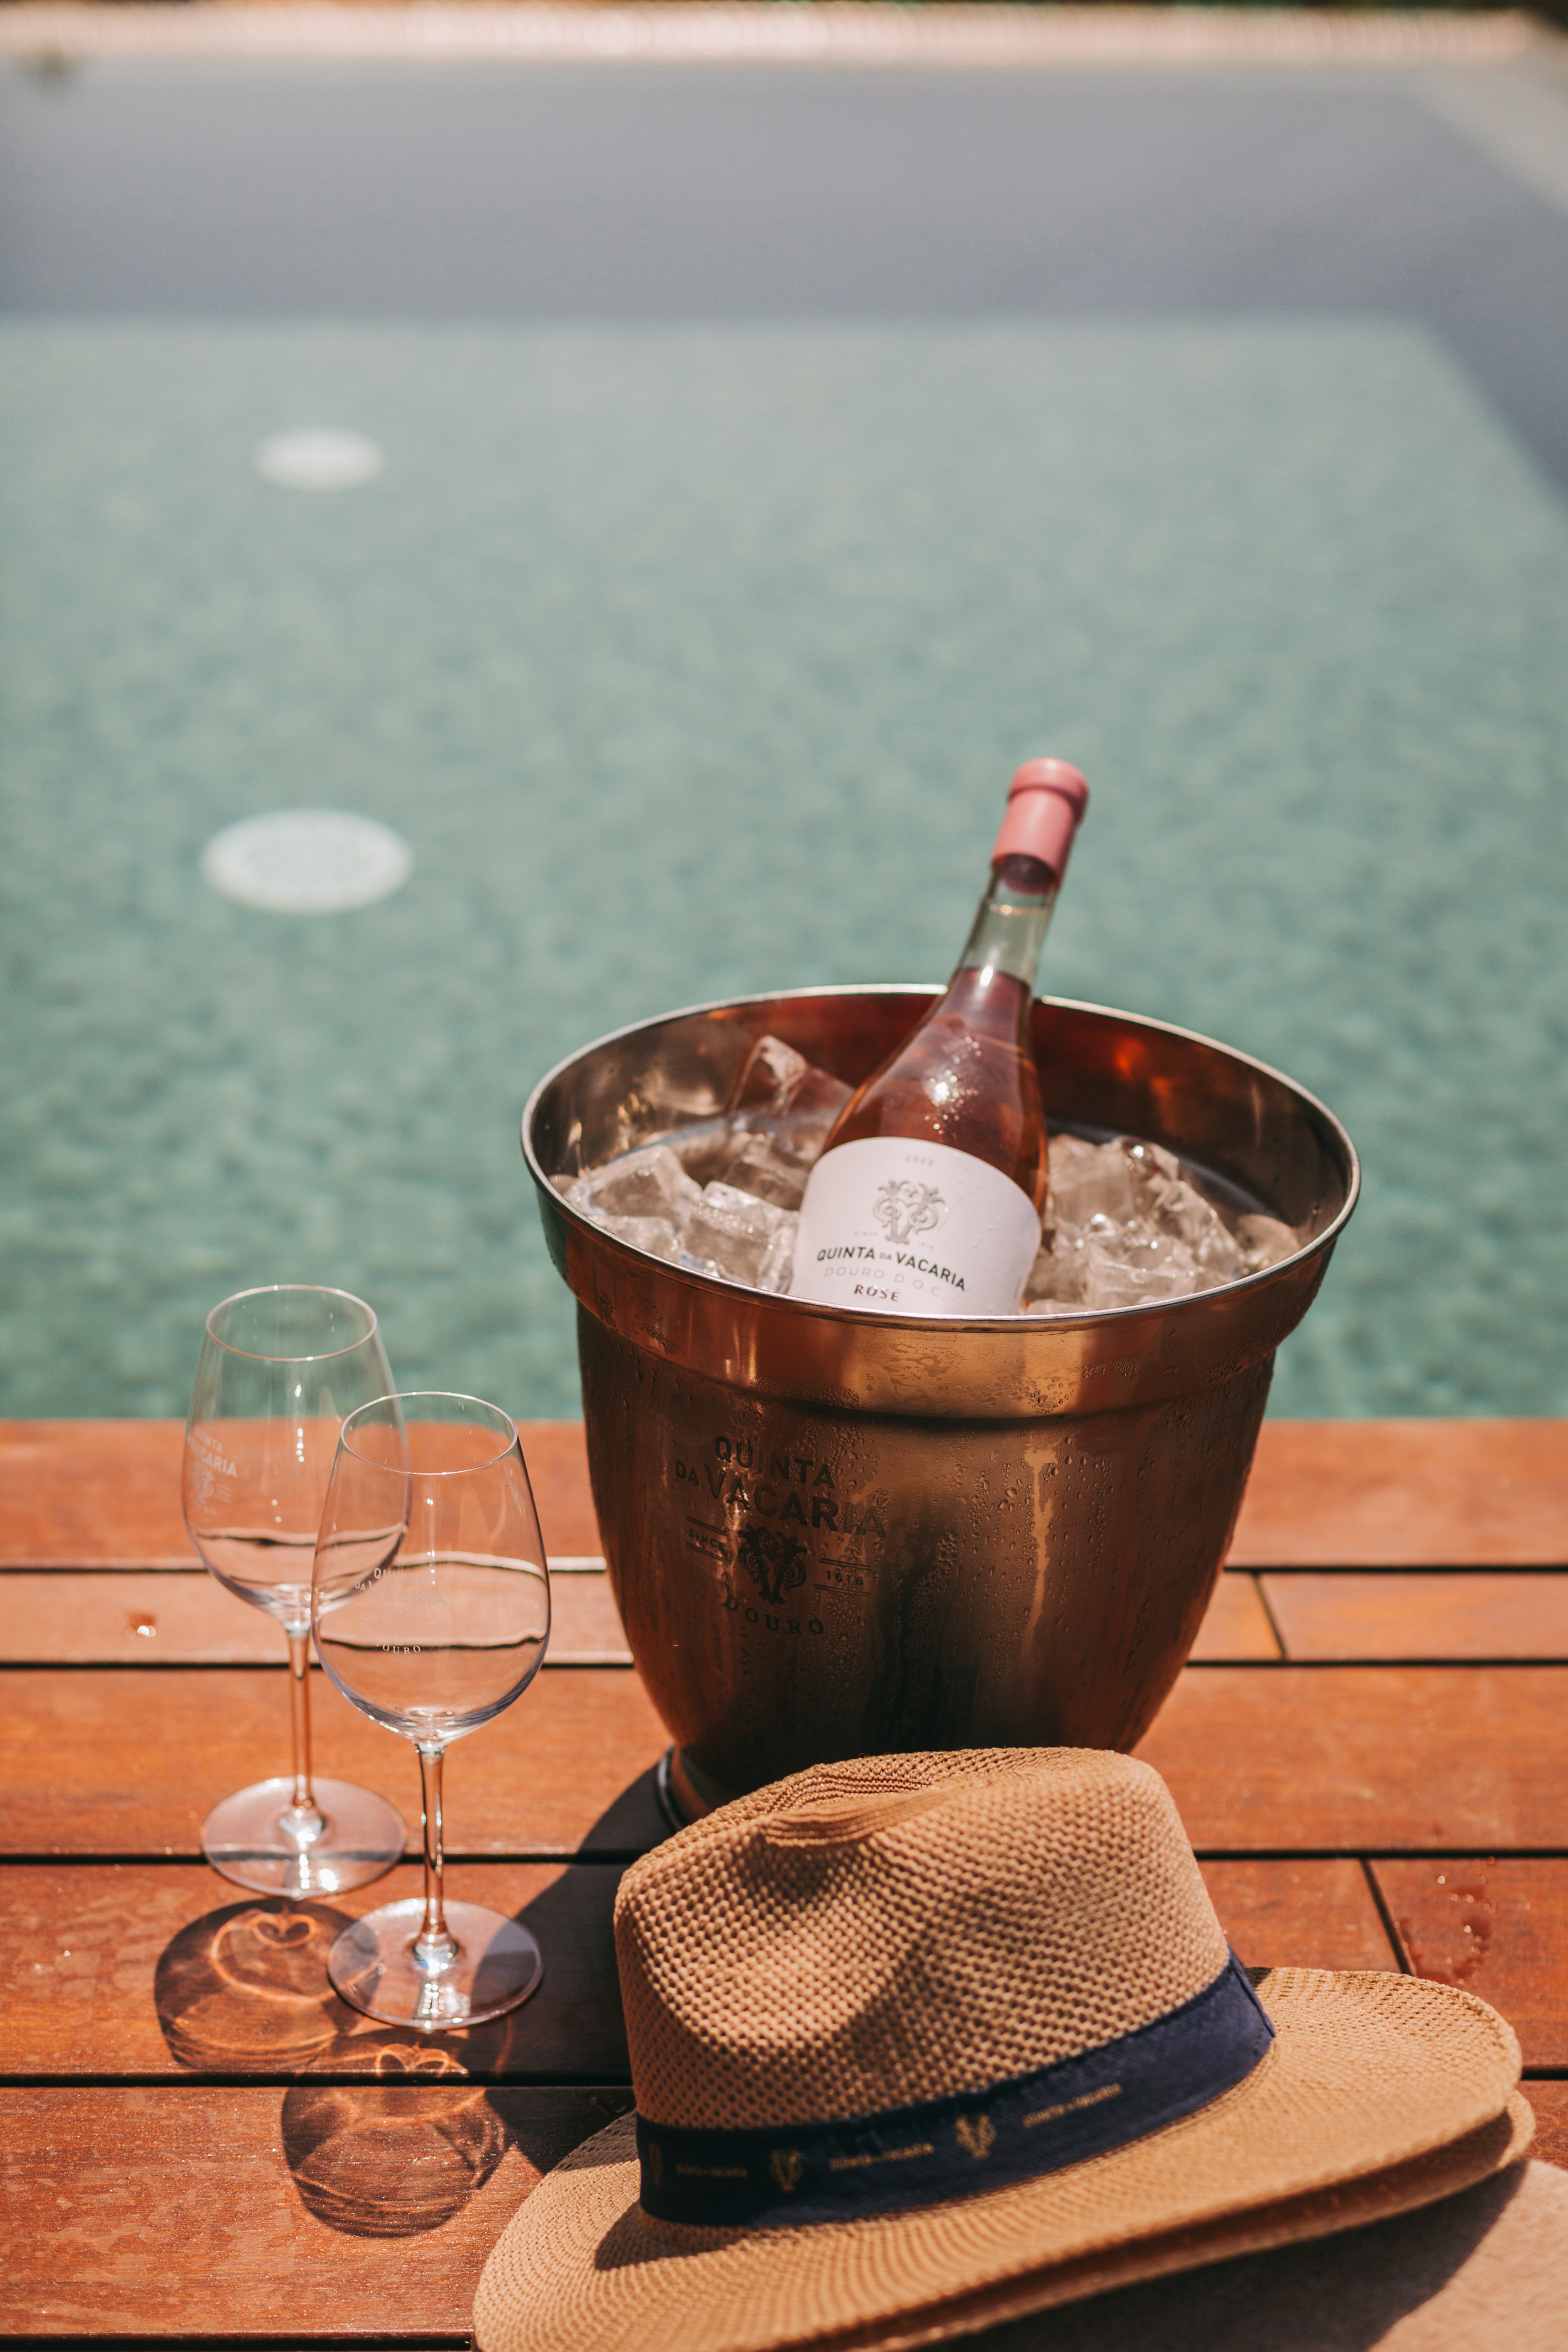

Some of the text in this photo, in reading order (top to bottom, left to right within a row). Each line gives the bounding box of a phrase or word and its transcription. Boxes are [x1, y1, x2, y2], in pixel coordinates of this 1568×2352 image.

[905, 1154, 934, 1166] 2022
[817, 1247, 875, 1261] QUINTA
[897, 1251, 965, 1291] VACARIA
[824, 1267, 884, 1279] DOURO
[715, 1436, 835, 1489] QUINTA
[676, 1460, 886, 1538] DA VACARIA
[374, 1568, 424, 1586] QUINTA
[826, 1571, 863, 1585] 1616
[355, 1581, 446, 1605] DA VACARIA
[723, 1595, 824, 1635] DOURO
[373, 1638, 421, 1655] DOURO
